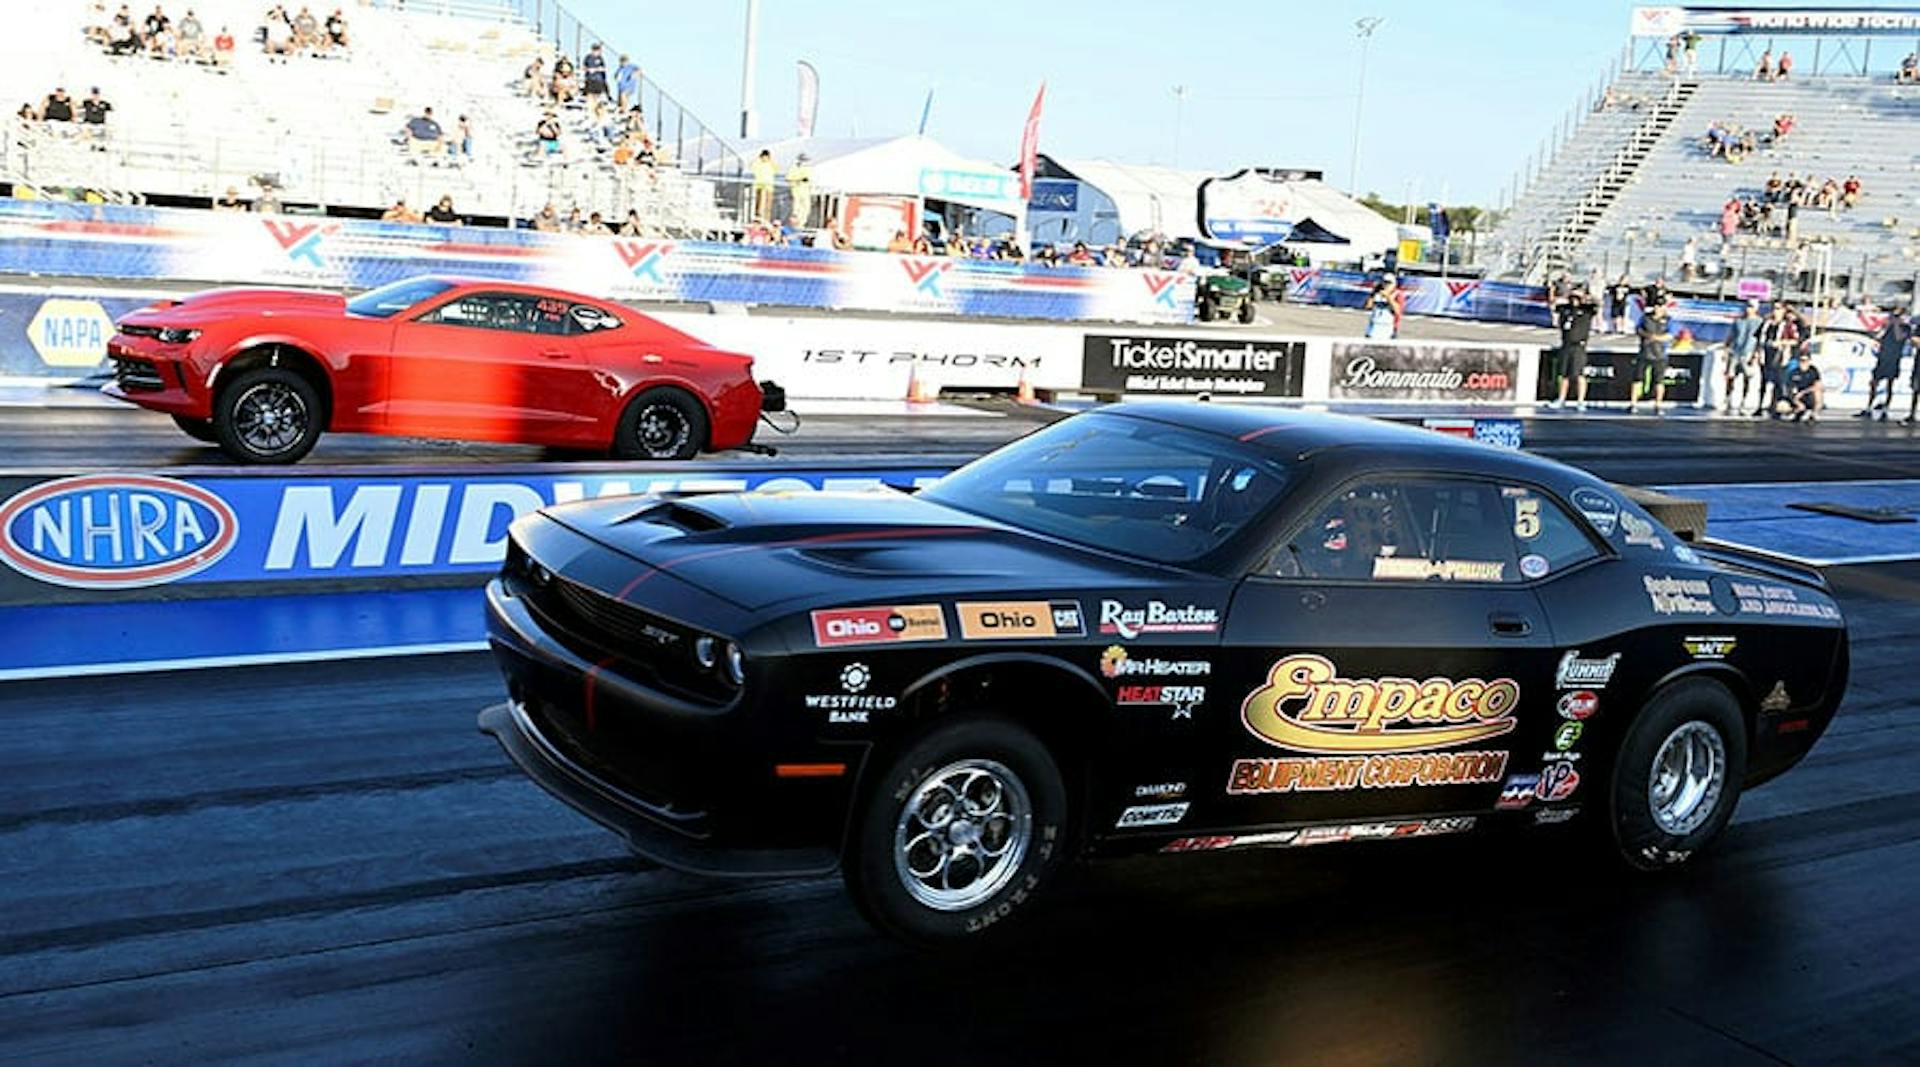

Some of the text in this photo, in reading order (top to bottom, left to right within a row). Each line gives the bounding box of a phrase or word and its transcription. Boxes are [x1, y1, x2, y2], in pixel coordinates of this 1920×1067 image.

[44, 316, 101, 348] NAPA
[803, 350, 878, 363] 1ST
[1110, 338, 1284, 371] TicketSmarter
[32, 493, 206, 562] NHRA
[1513, 498, 1541, 541] 5
[826, 617, 881, 637] Ohio
[980, 611, 1036, 629] Ohio
[1101, 599, 1219, 639] Ray Barton
[805, 694, 897, 709] WESTFIELD
[1117, 686, 1206, 703] HEATSTAR
[1240, 654, 1520, 754] Empaco
[828, 709, 869, 723] BANK
[1227, 750, 1509, 794] EQUIPMENT CORPORATION
